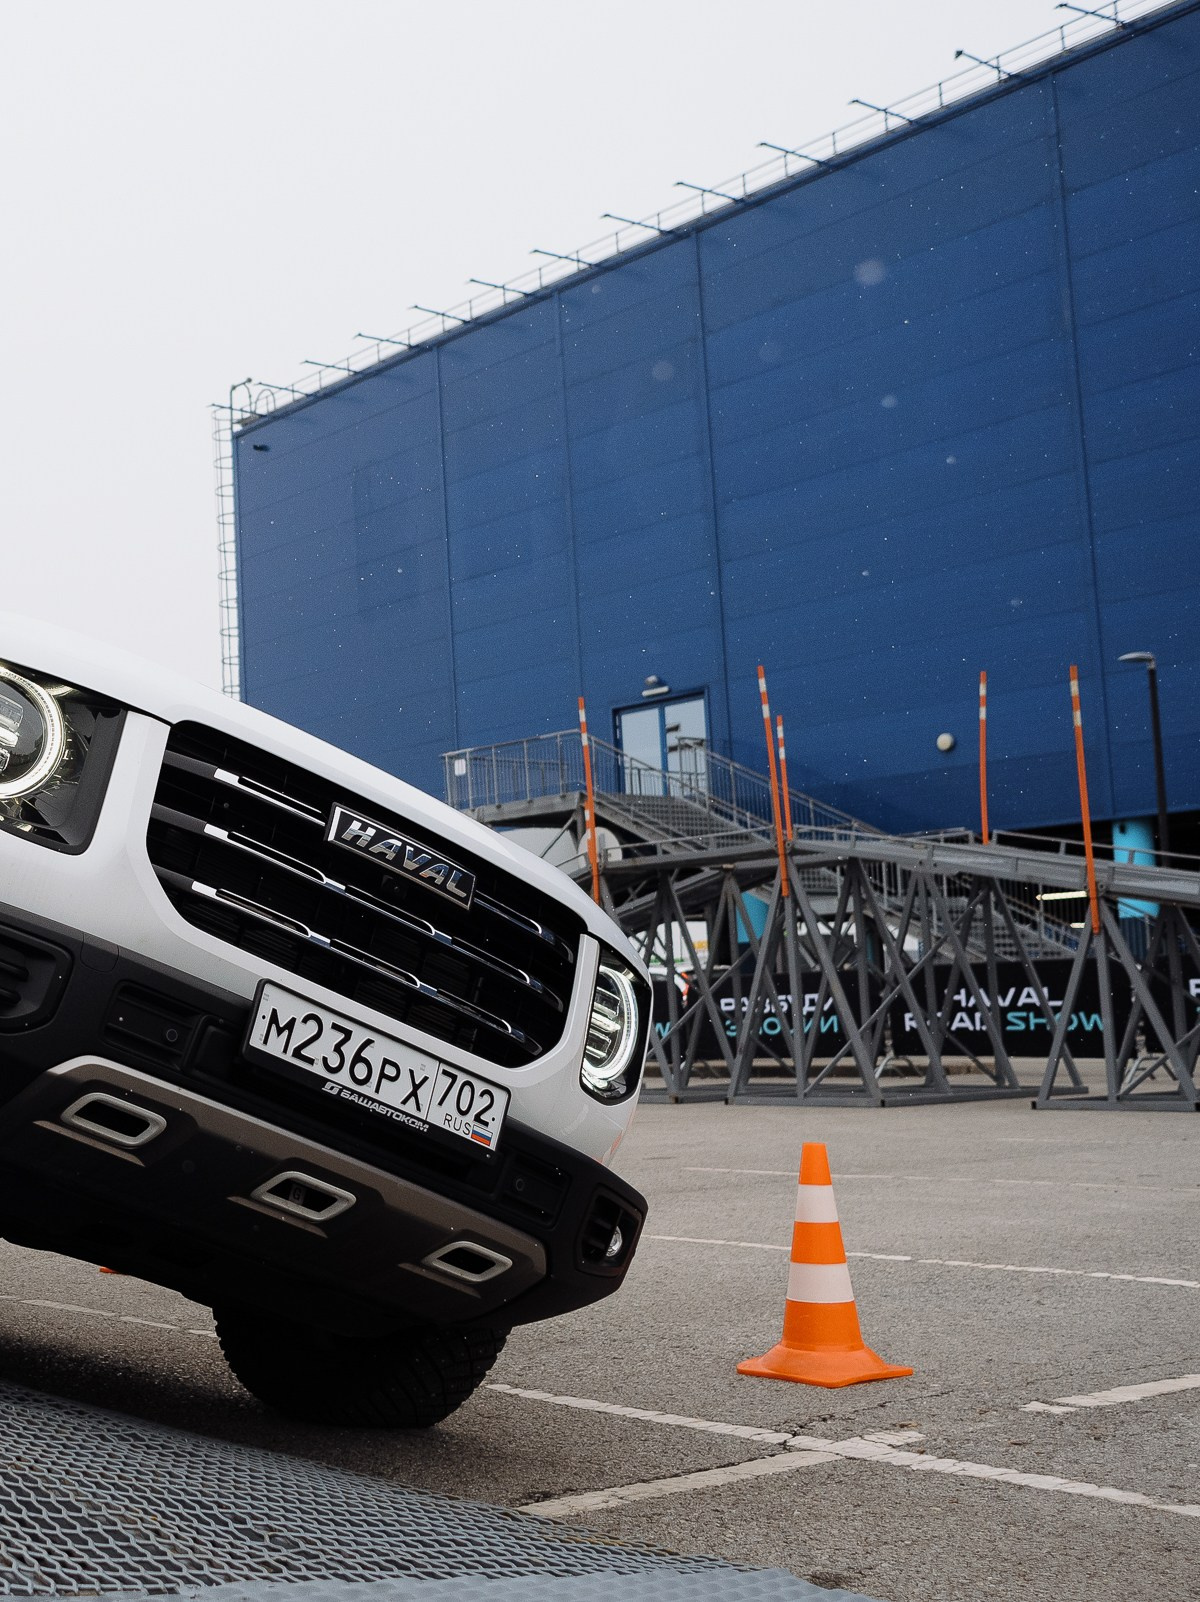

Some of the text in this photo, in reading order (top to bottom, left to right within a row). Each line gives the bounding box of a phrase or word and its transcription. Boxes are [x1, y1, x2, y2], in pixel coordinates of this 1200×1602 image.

[341, 820, 467, 898] HAVAL
[904, 1011, 988, 1032] RA
[340, 1089, 430, 1133] БАШАВТОКОМ
[437, 1069, 496, 1128] 702
[443, 1113, 471, 1136] RUS
